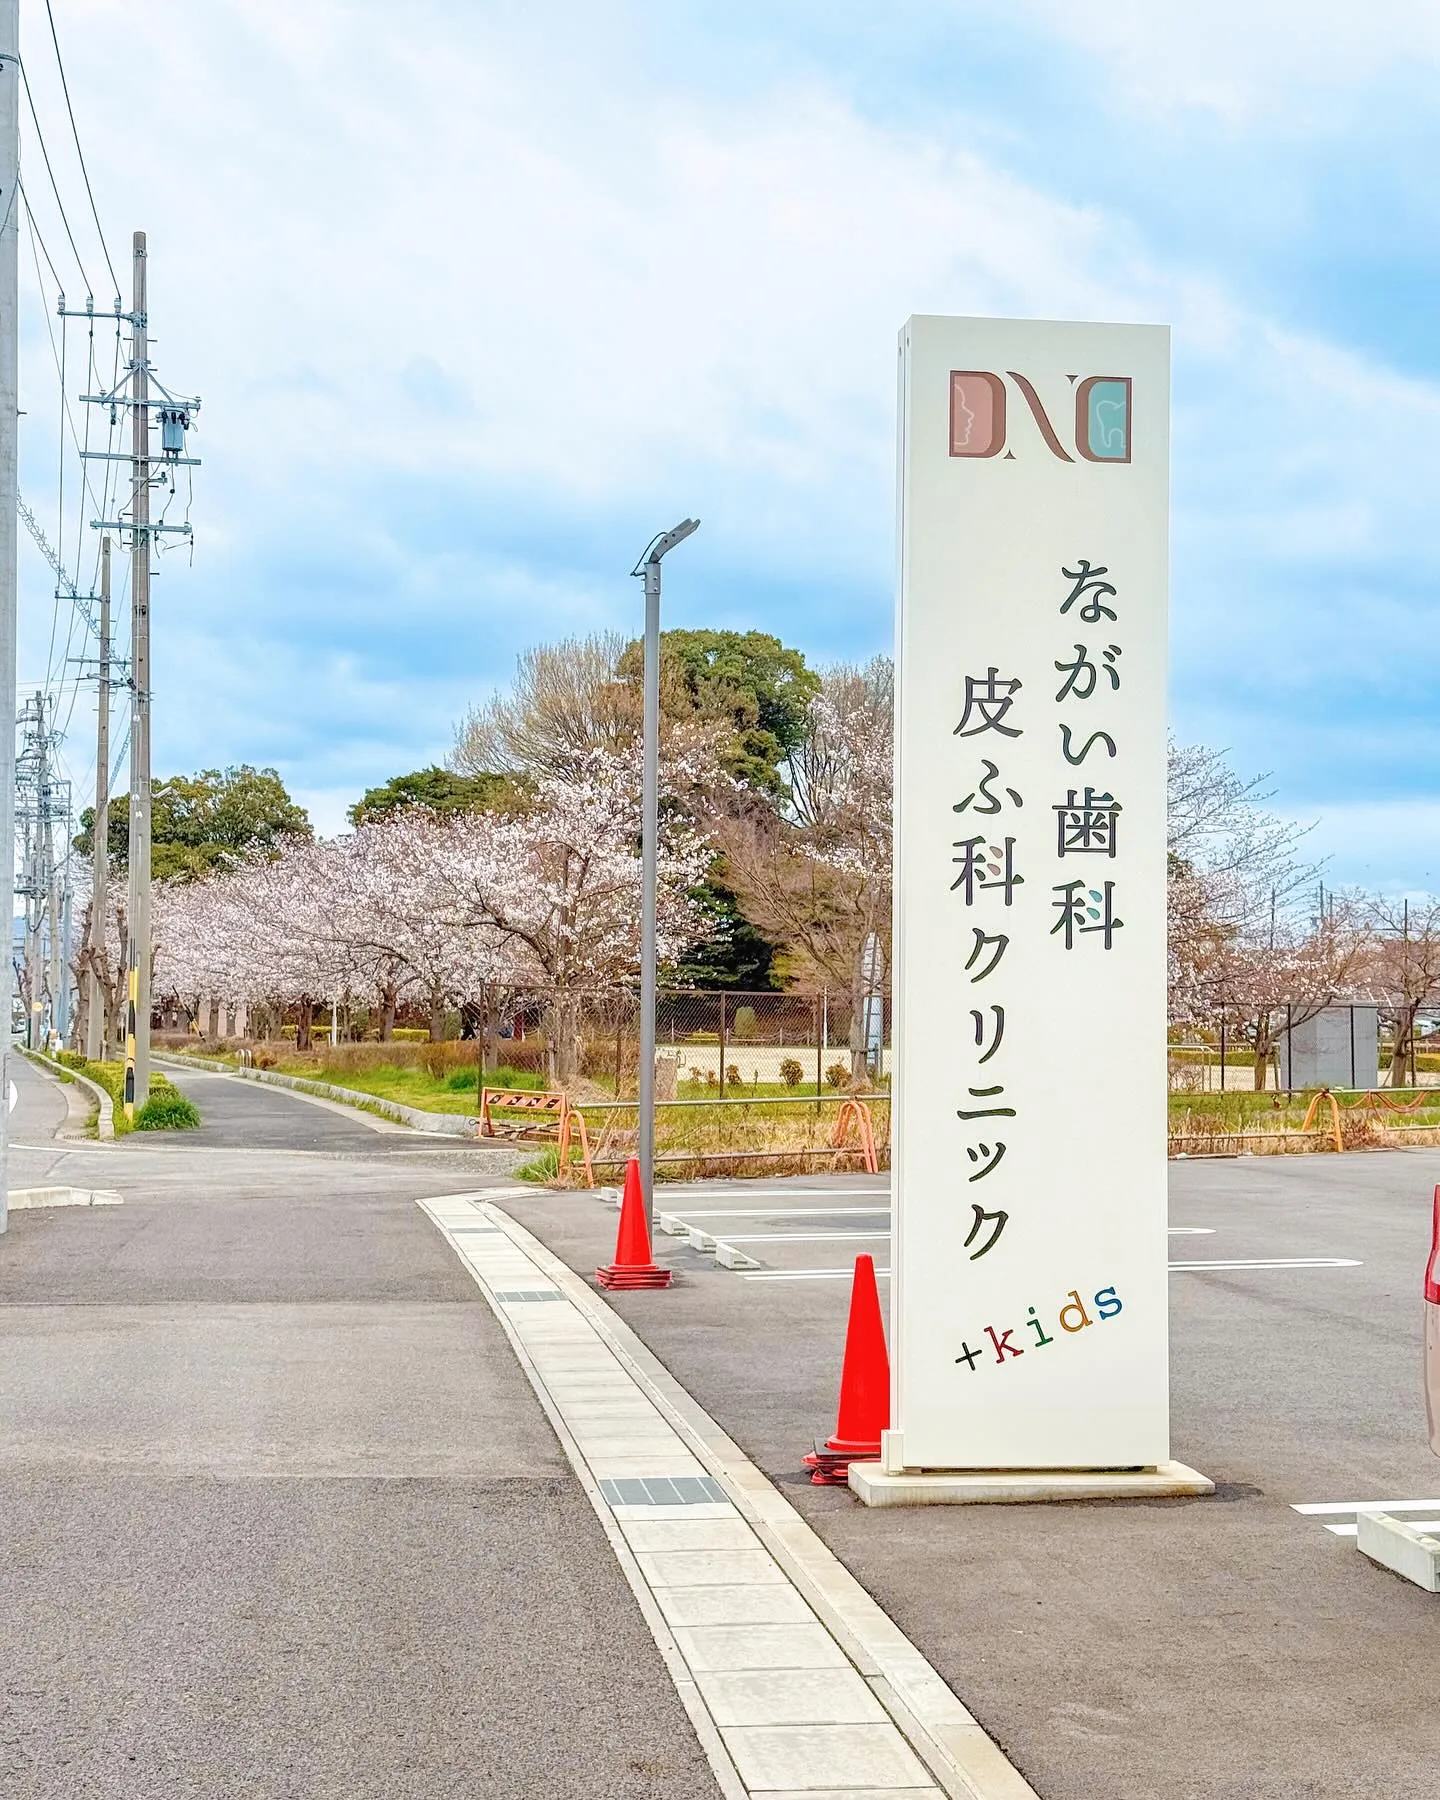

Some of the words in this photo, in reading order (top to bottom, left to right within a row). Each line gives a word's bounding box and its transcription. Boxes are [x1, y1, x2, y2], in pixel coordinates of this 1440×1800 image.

[1050, 559, 1124, 951] ながい歯科
[950, 667, 1024, 1261] 皮ふ科クリニック
[955, 1286, 1123, 1371] +kids
